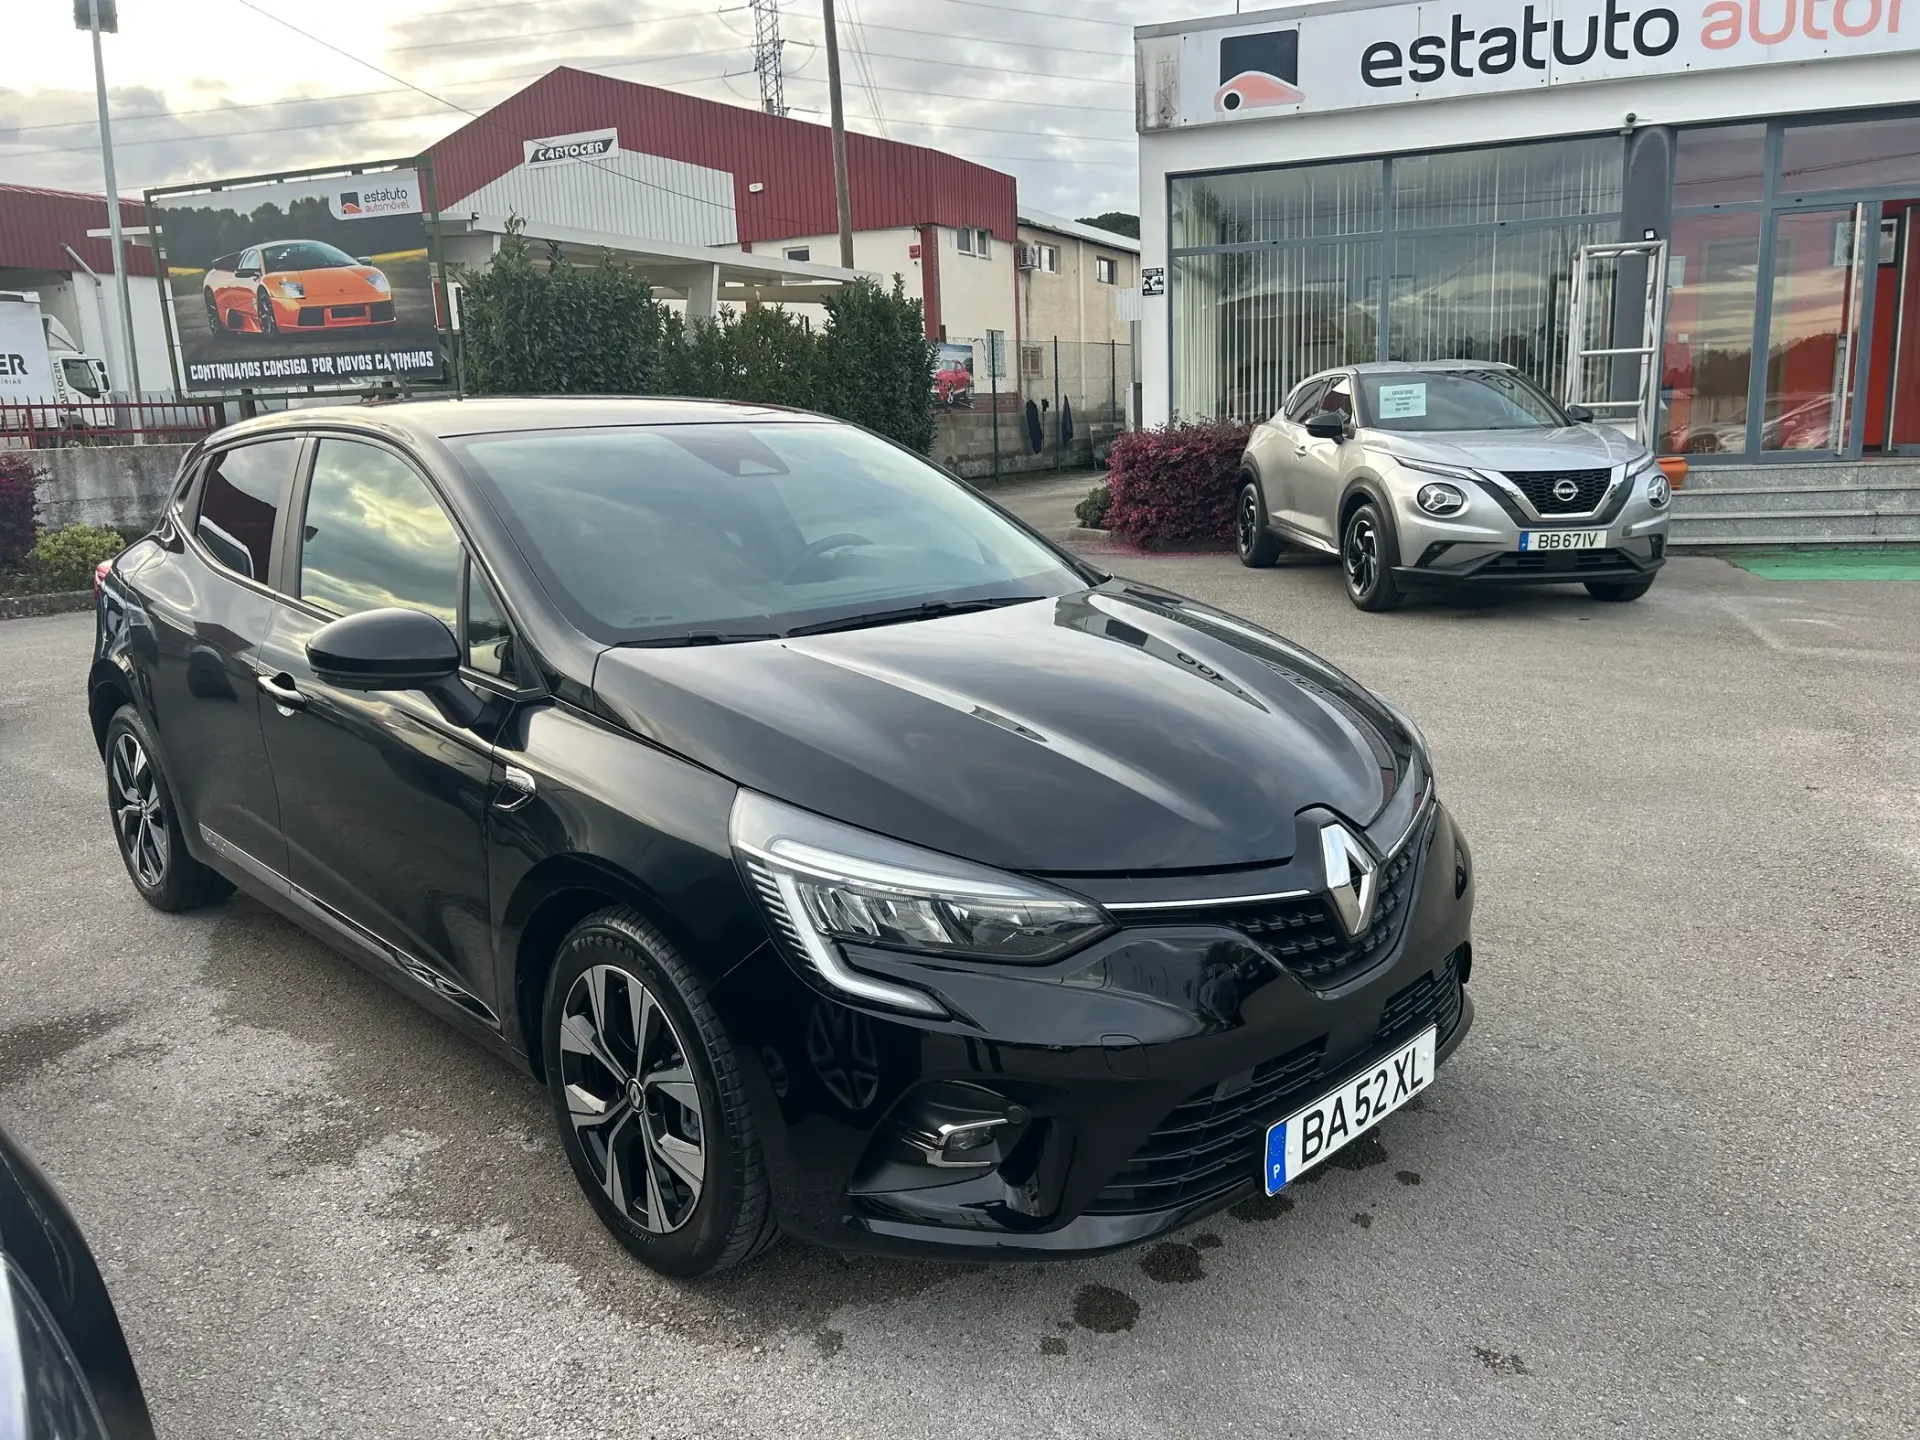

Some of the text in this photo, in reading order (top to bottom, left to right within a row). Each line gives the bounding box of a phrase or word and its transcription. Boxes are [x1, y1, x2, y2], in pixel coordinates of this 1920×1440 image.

[1360, 0, 1680, 88] estatuto
[538, 141, 604, 161] CARTOCER
[364, 186, 408, 203] estatuto
[365, 200, 410, 213] automóvel
[190, 361, 262, 382] CONTINUAMOS
[312, 356, 336, 375] POR
[337, 353, 373, 375] NOVOS
[374, 350, 434, 371] CAMINHOS
